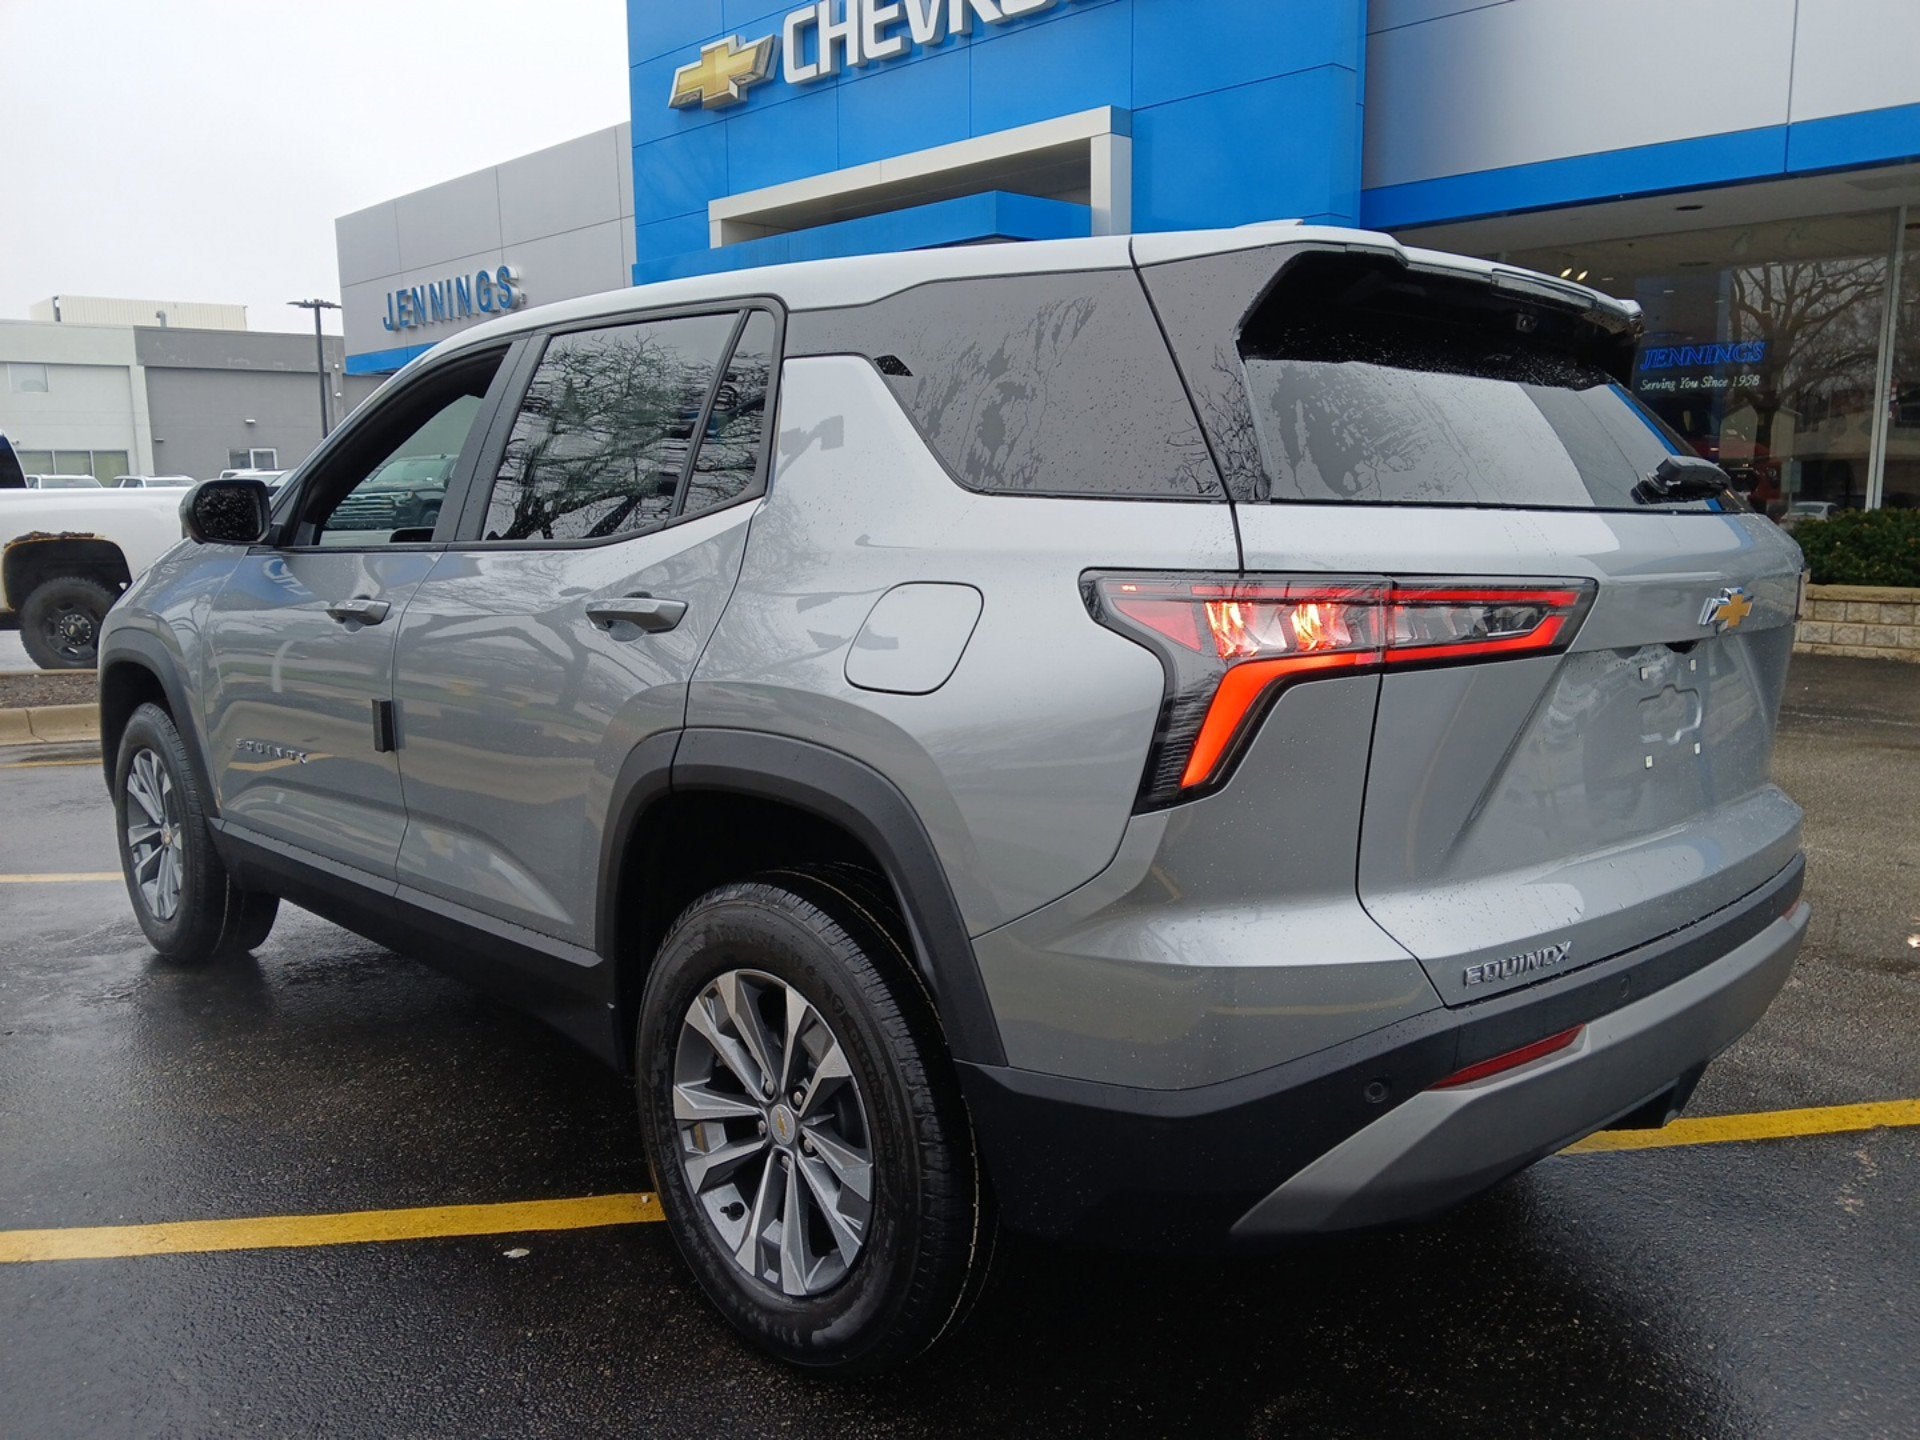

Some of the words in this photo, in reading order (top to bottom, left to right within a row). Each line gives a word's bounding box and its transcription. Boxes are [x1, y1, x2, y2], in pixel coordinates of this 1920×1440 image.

[782, 0, 1054, 84] CHEV
[382, 265, 518, 332] JENNINGS
[1640, 341, 1766, 371] JENNINGS
[1640, 379, 1676, 392] Serving
[1680, 377, 1699, 389] You
[1701, 375, 1729, 388] Since
[1732, 374, 1761, 388] 1958
[1463, 941, 1572, 989] EQUINOX
